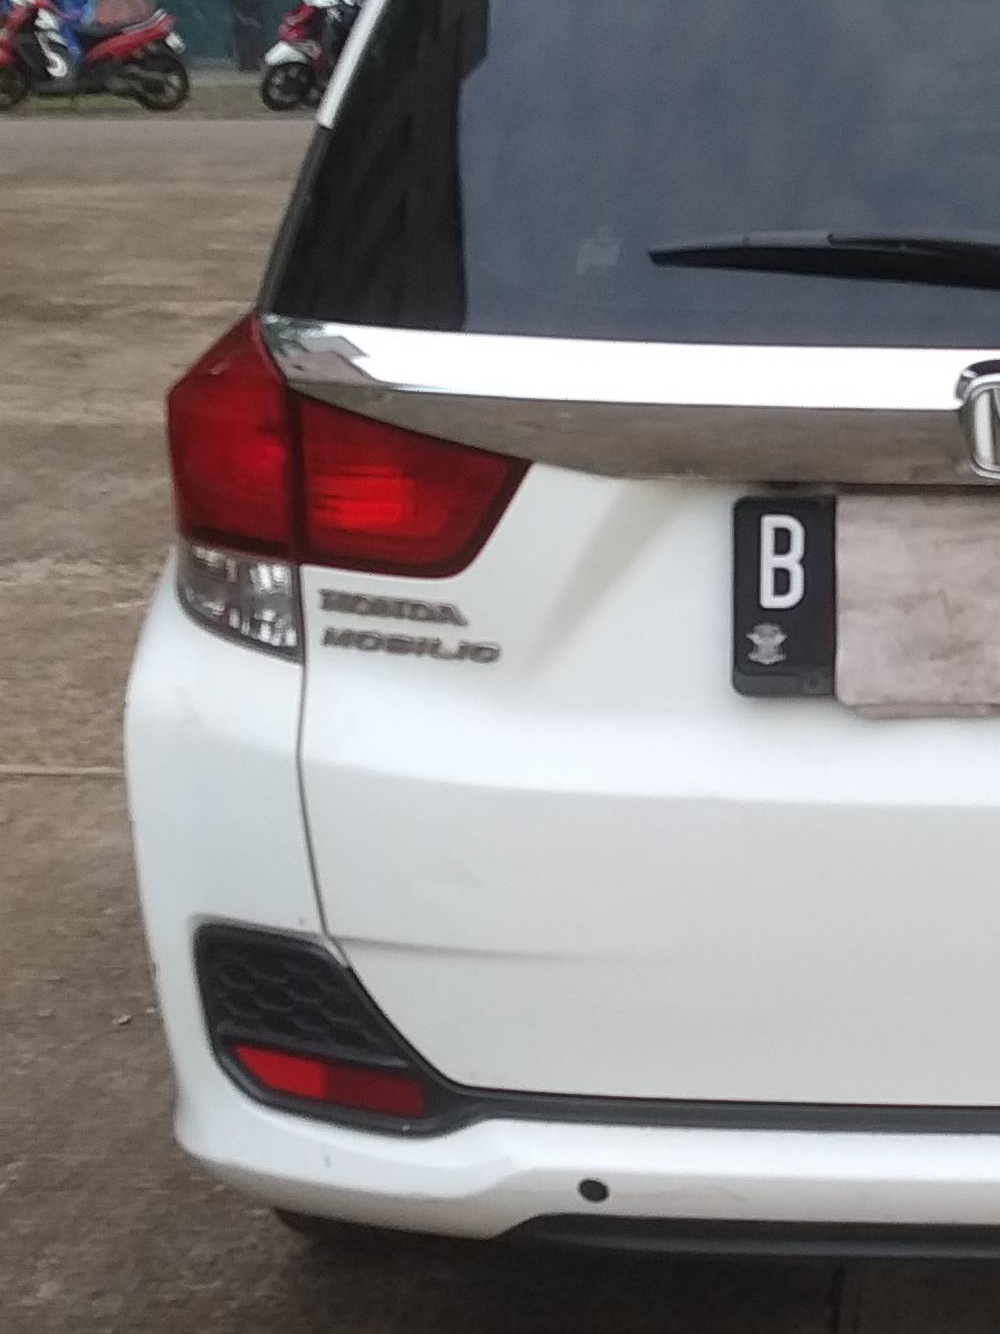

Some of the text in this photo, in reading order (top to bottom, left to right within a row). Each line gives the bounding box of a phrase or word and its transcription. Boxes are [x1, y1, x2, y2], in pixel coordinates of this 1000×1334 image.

[760, 514, 805, 609] B
[319, 588, 468, 627] HONDA
[322, 626, 502, 664] MOBILIO
